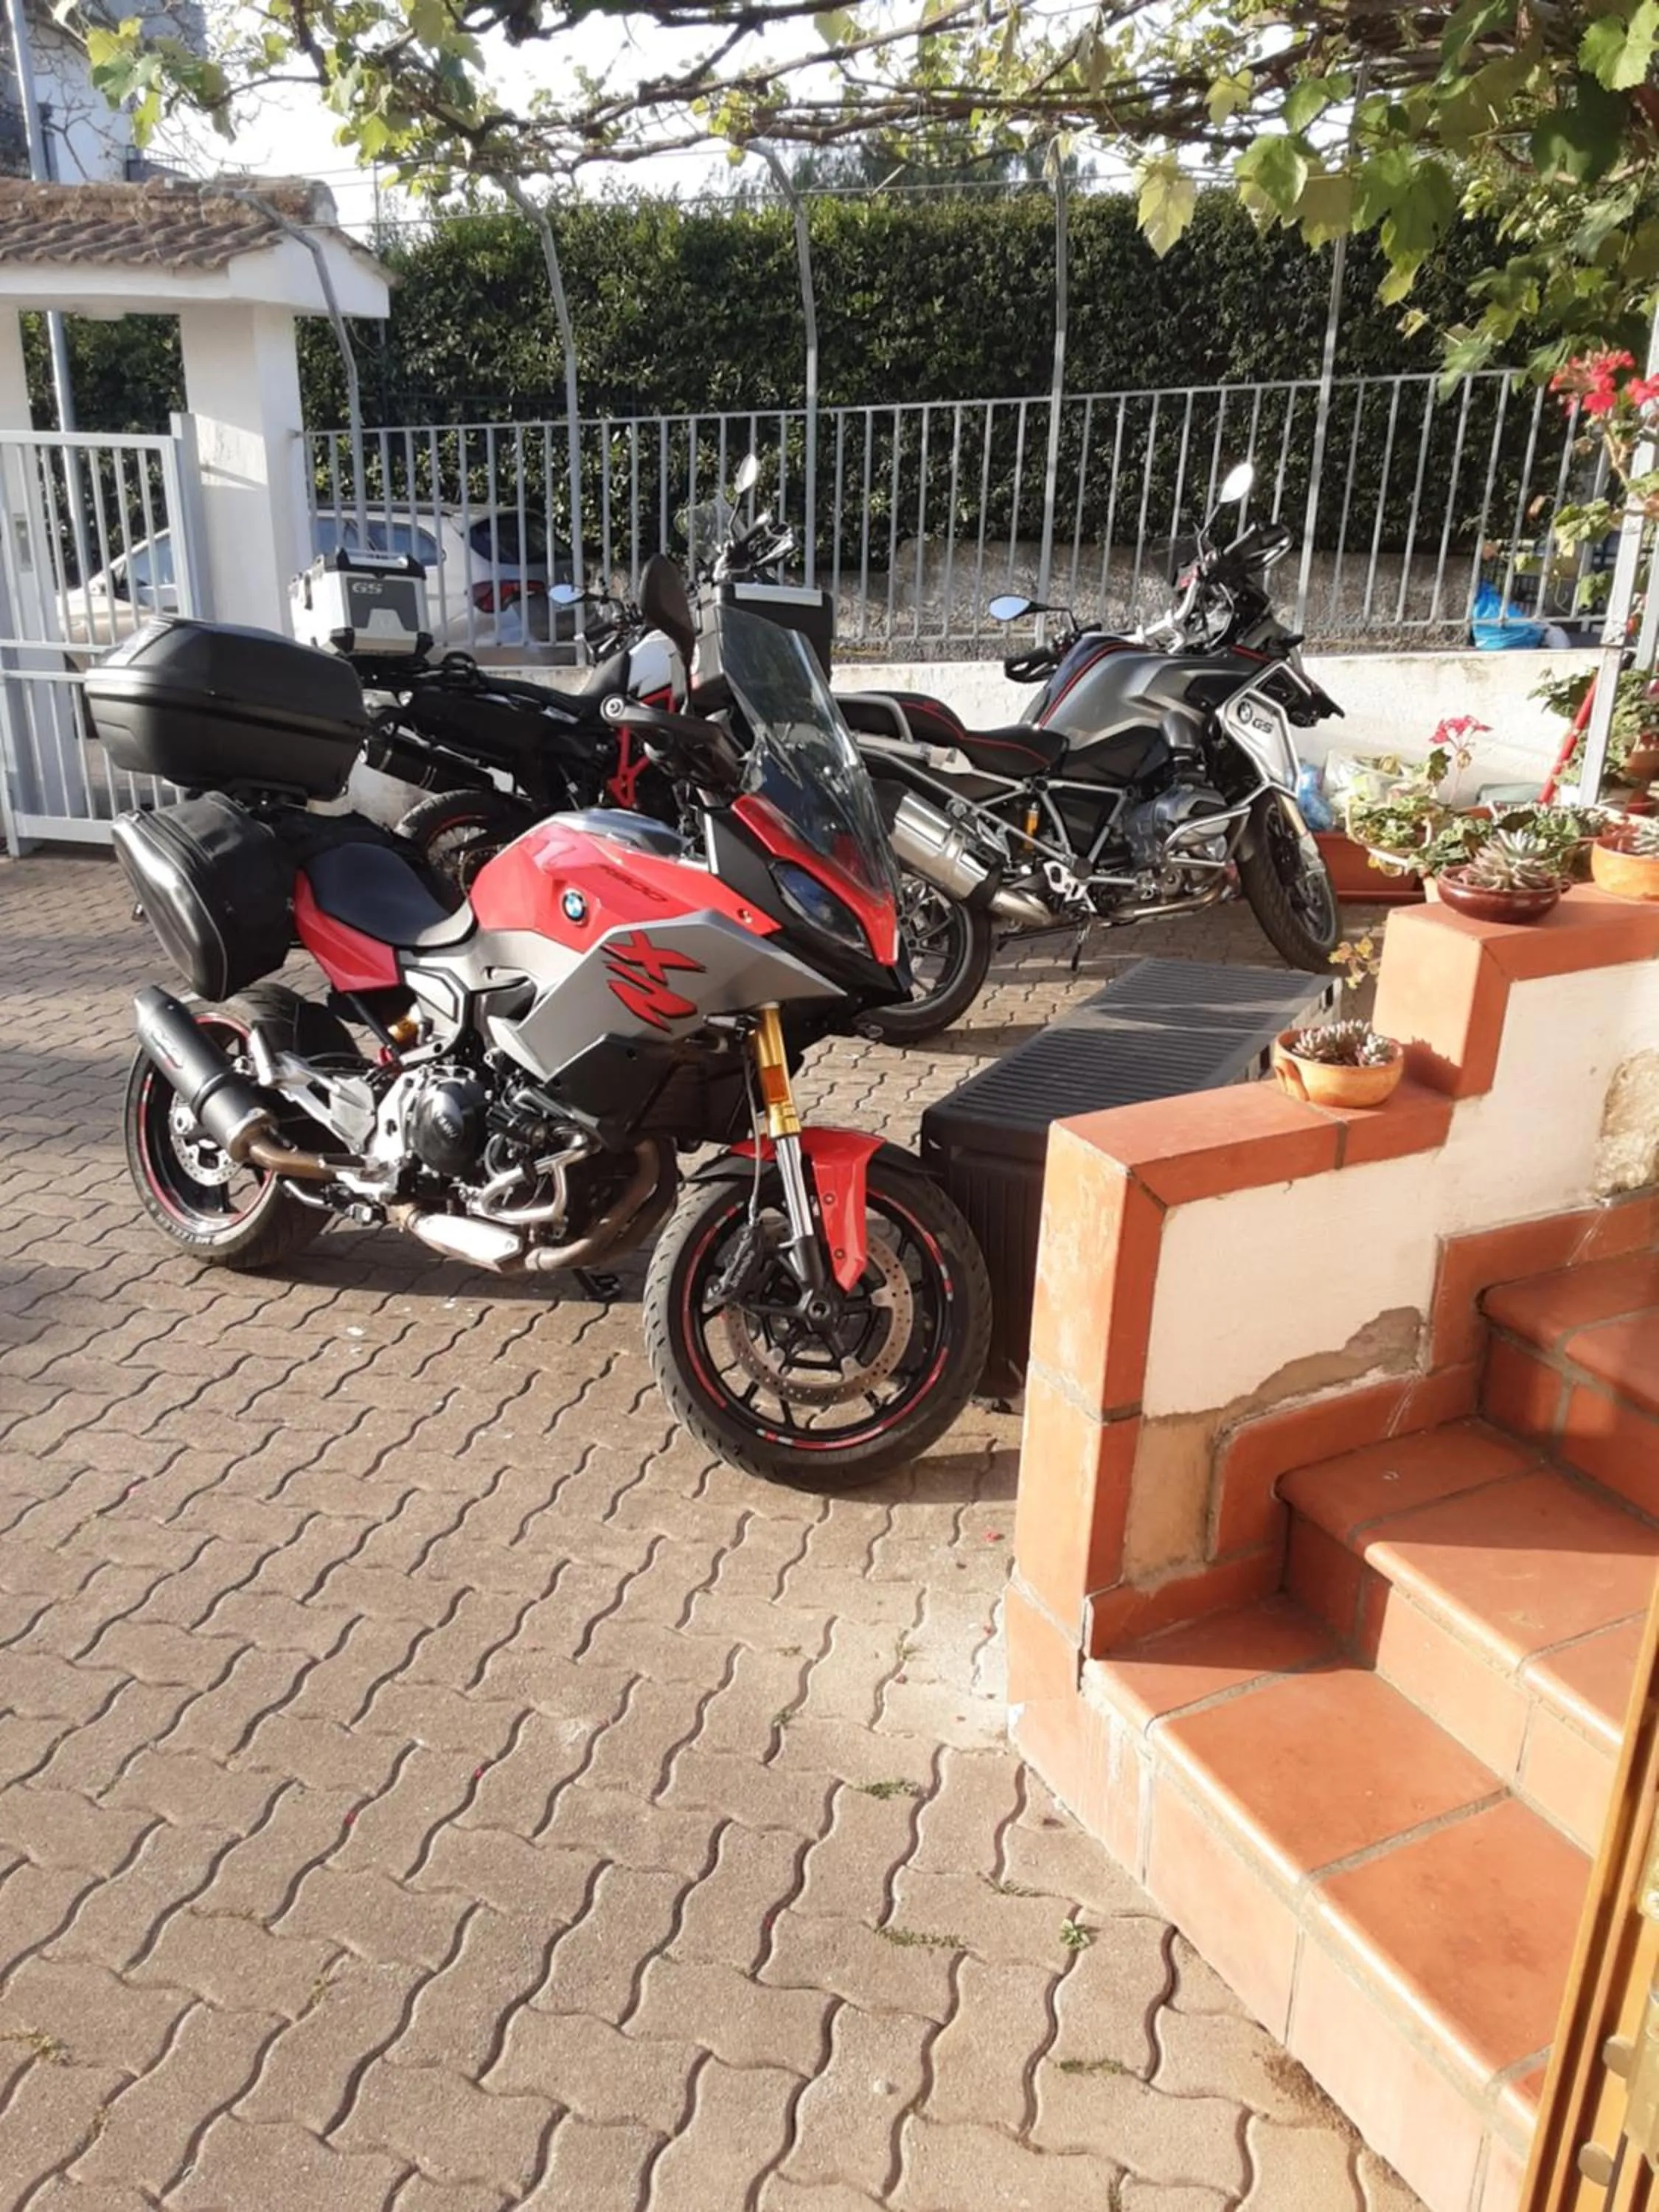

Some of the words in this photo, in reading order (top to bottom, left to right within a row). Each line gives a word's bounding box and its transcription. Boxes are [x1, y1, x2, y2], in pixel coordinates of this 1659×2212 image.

[352, 582, 383, 594] GS
[1252, 718, 1274, 734] GS
[599, 929, 708, 1034] XR
